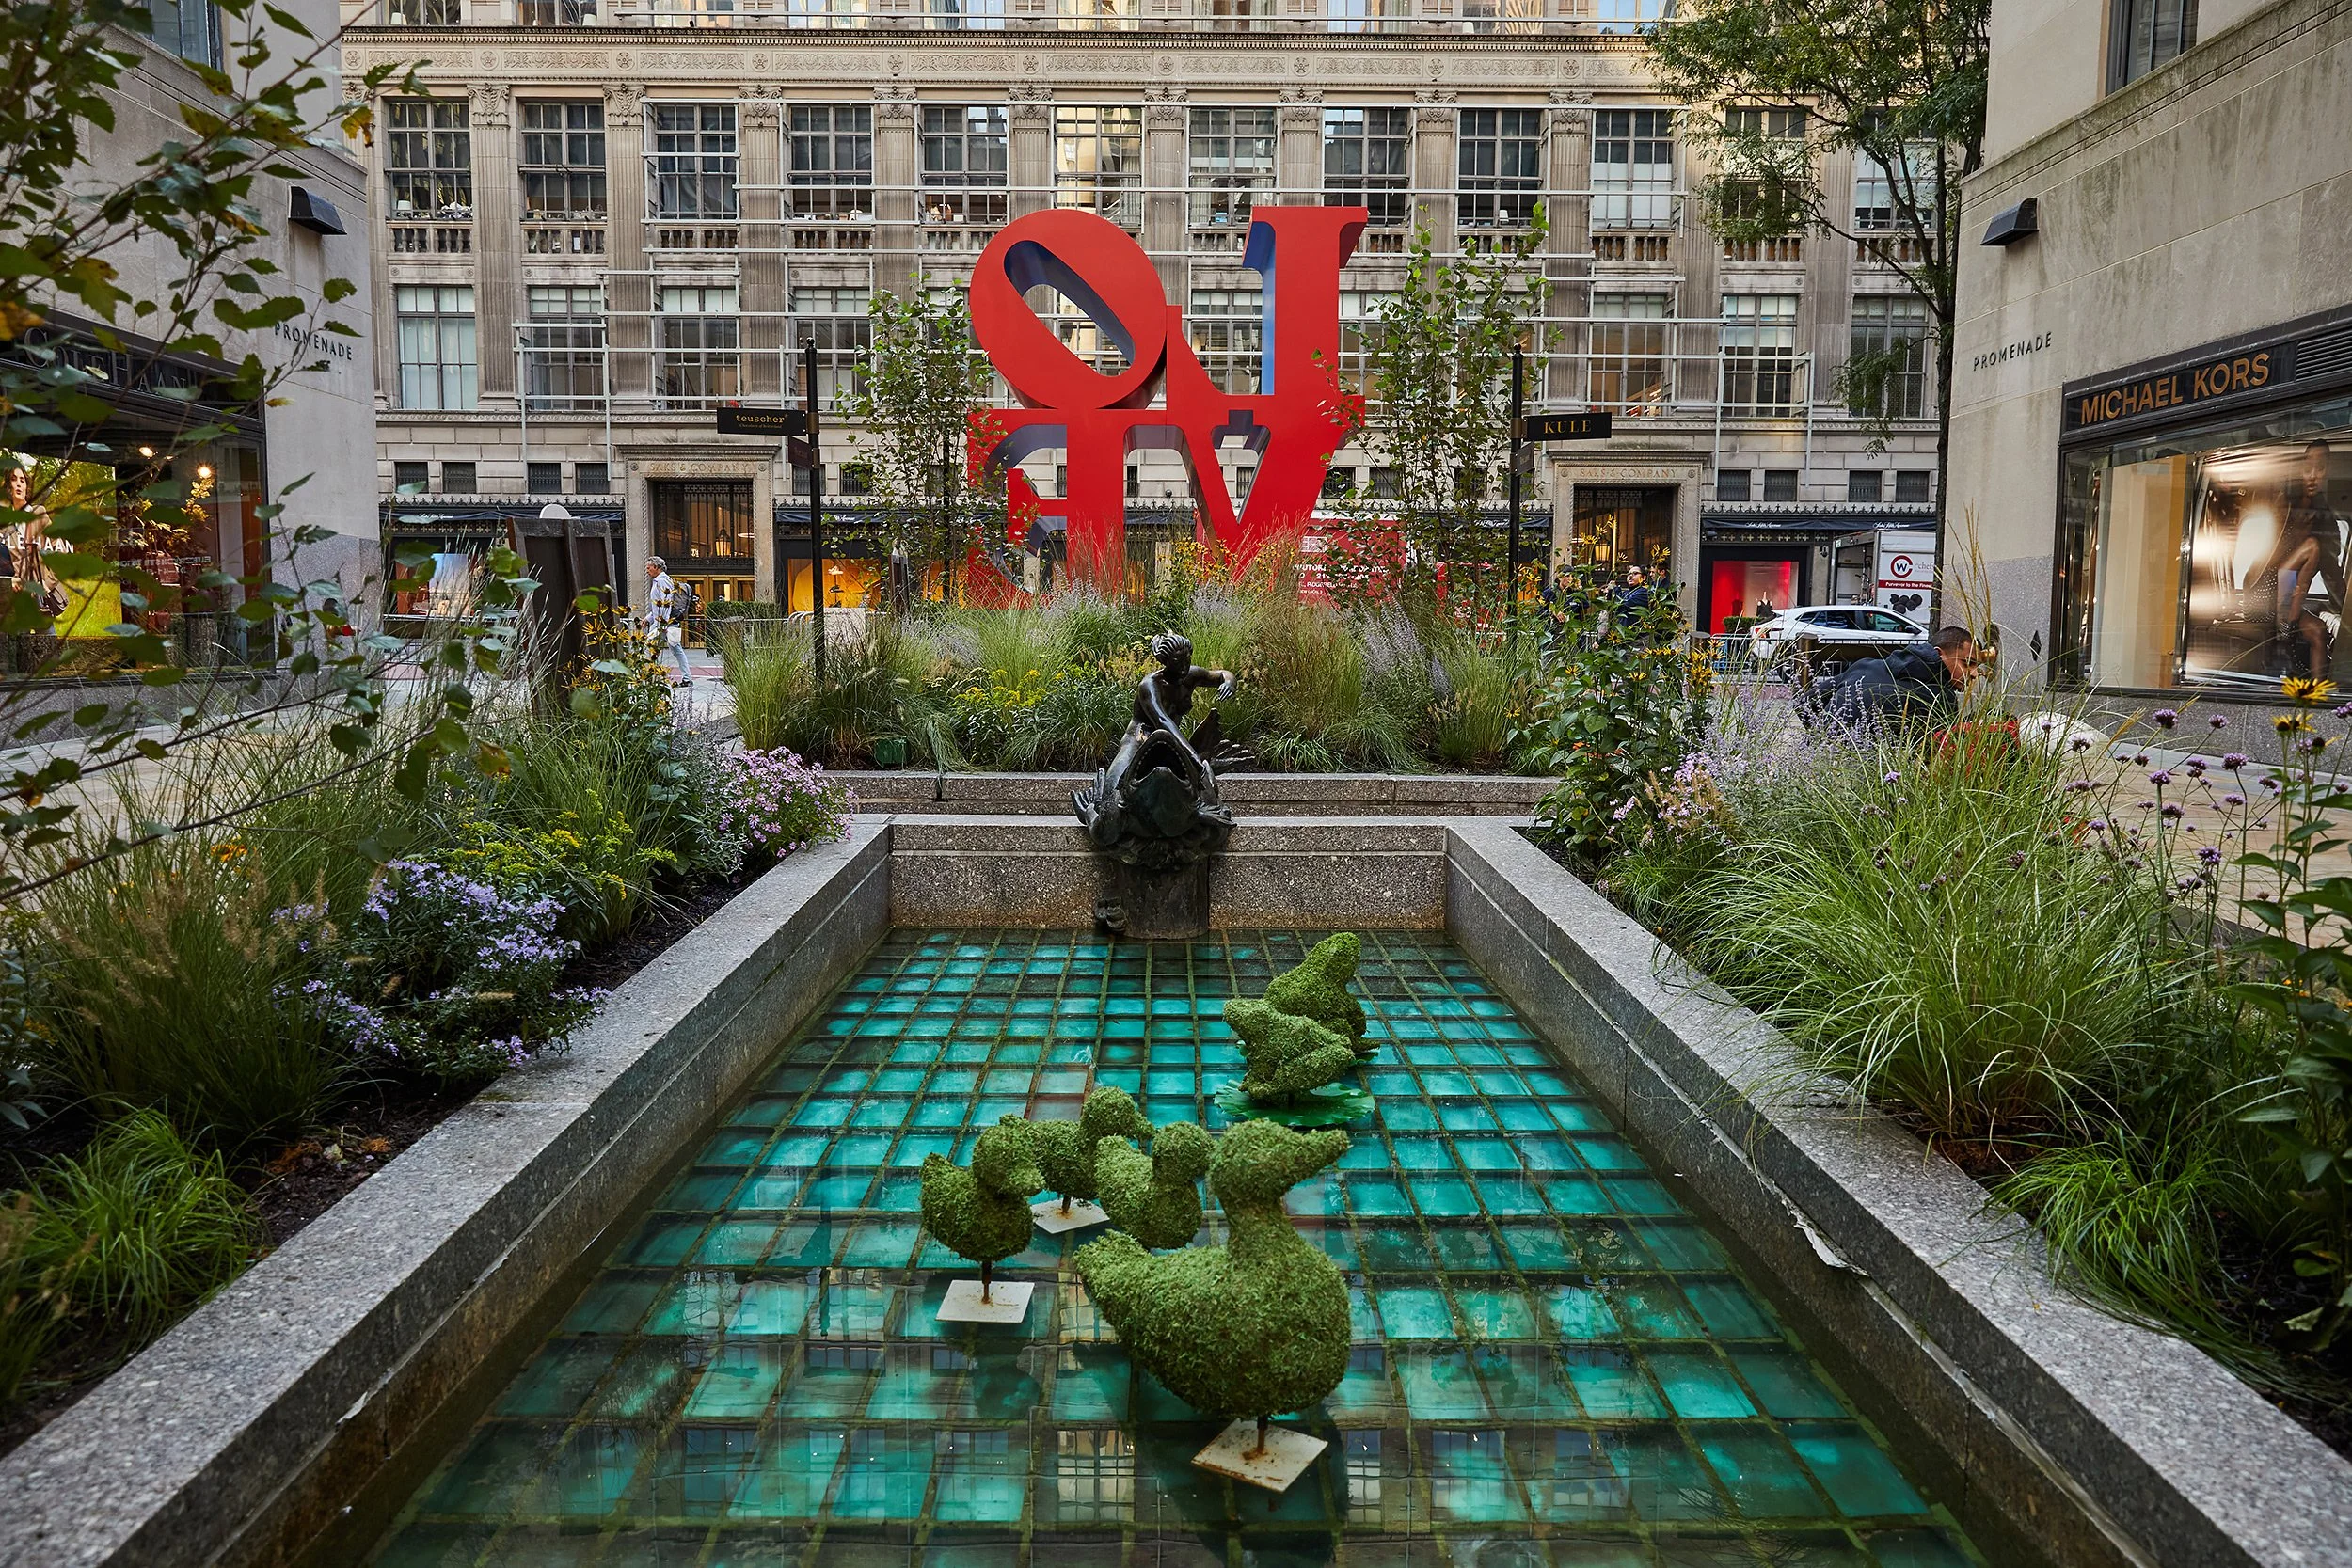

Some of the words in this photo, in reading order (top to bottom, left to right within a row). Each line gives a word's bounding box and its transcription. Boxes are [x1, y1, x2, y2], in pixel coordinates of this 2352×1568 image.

[275, 322, 352, 361] PROMENADE
[1973, 331, 2052, 372] PROMENADE
[2080, 375, 2183, 425] MICHAEL
[2193, 353, 2270, 400] KORS
[736, 414, 785, 423] teuscher
[1544, 420, 1592, 434] KULE
[649, 463, 676, 471] SAKS
[690, 463, 749, 472] COMPANY
[1580, 468, 1606, 478] SAKS
[1620, 468, 1677, 478] COMPANY
